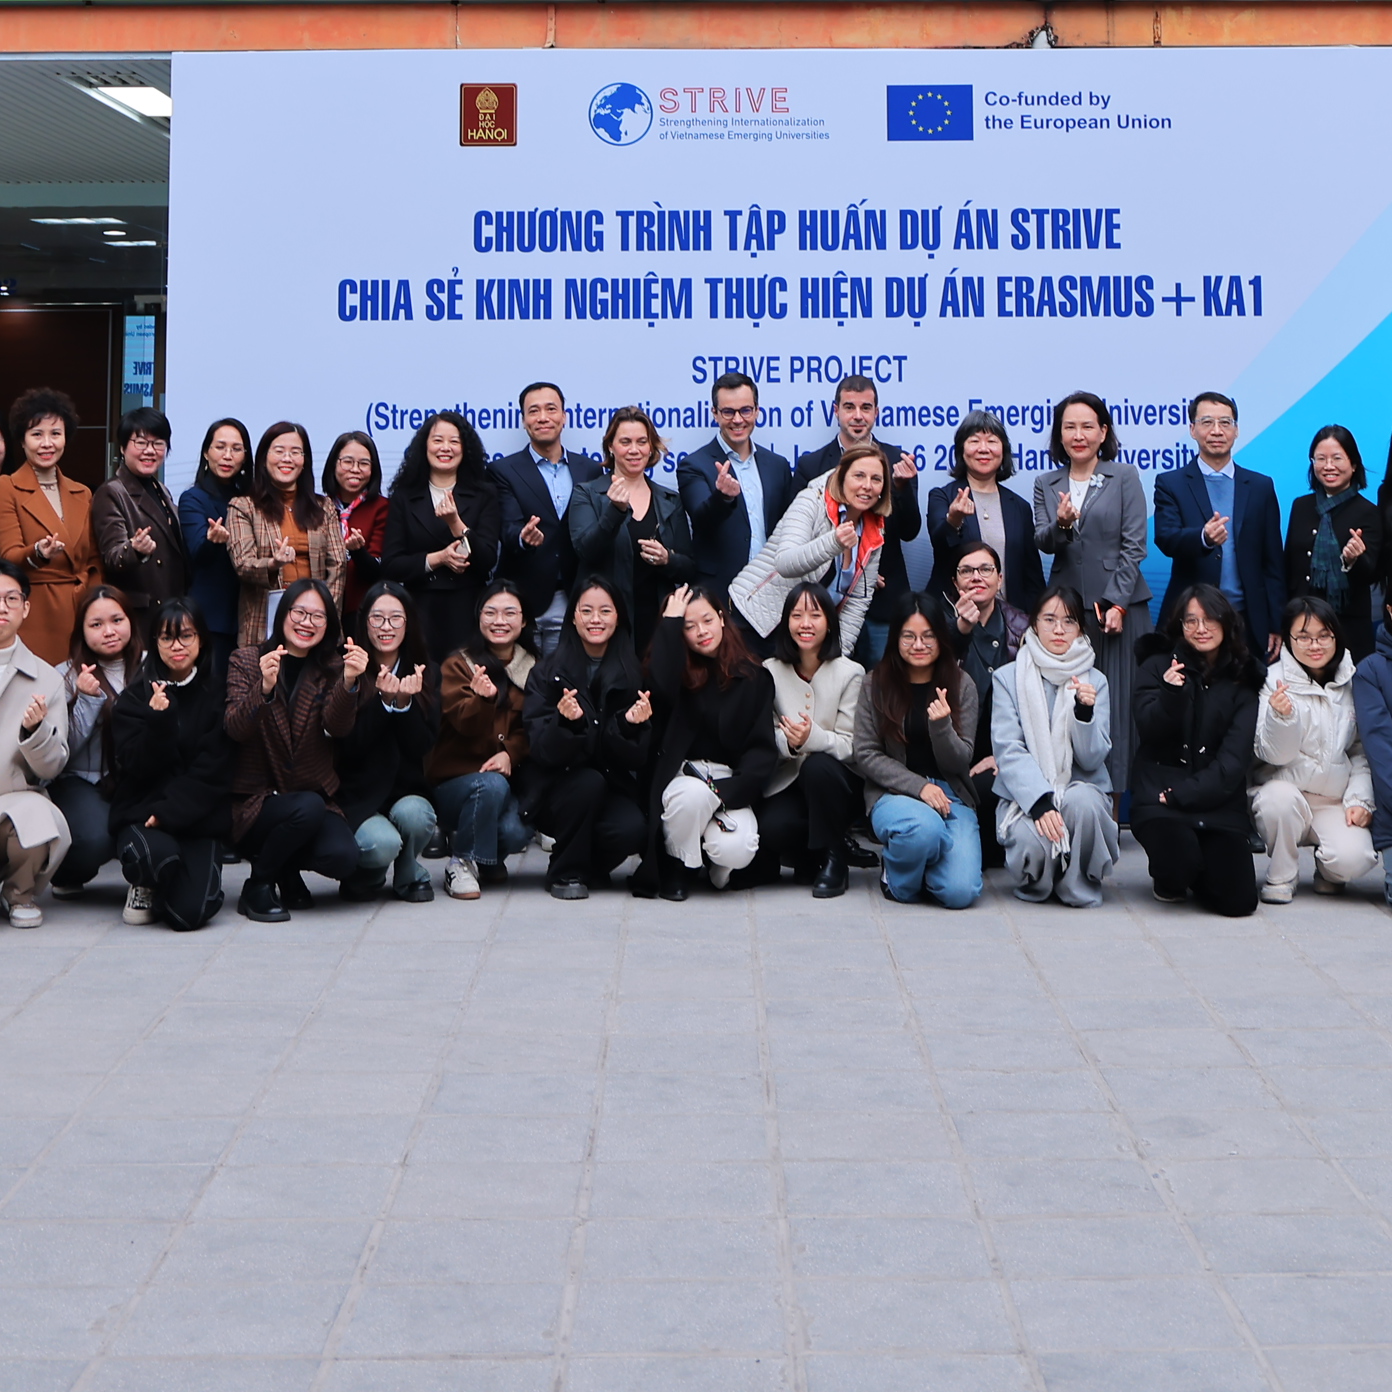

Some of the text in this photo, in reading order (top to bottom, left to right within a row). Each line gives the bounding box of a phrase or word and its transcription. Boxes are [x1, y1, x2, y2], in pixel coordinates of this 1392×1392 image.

[659, 88, 790, 113] STRIVE
[984, 91, 1111, 109] Co-funded by
[659, 117, 825, 128] Strengthening Internationalization
[984, 115, 1172, 133] the European Union
[659, 130, 830, 142] of Vietnamese Emerging Universities
[474, 199, 1122, 259] CHƯƠNG TRÌNH TẬP HUẤN DỰ ÁN STRIVE
[338, 279, 414, 322] CHIA
[425, 266, 463, 321] SẺ
[476, 279, 552, 320] KINH
[564, 271, 693, 327] NGHIỆM
[704, 274, 788, 328] THỰC
[800, 270, 873, 327] HIỆN
[885, 273, 929, 327] DỰ
[939, 267, 985, 317] ÁN
[997, 275, 1155, 318] ERASMUS
[1203, 275, 1263, 317] KA1
[692, 355, 908, 383] STRIVE PROJECT
[790, 400, 814, 428] of
